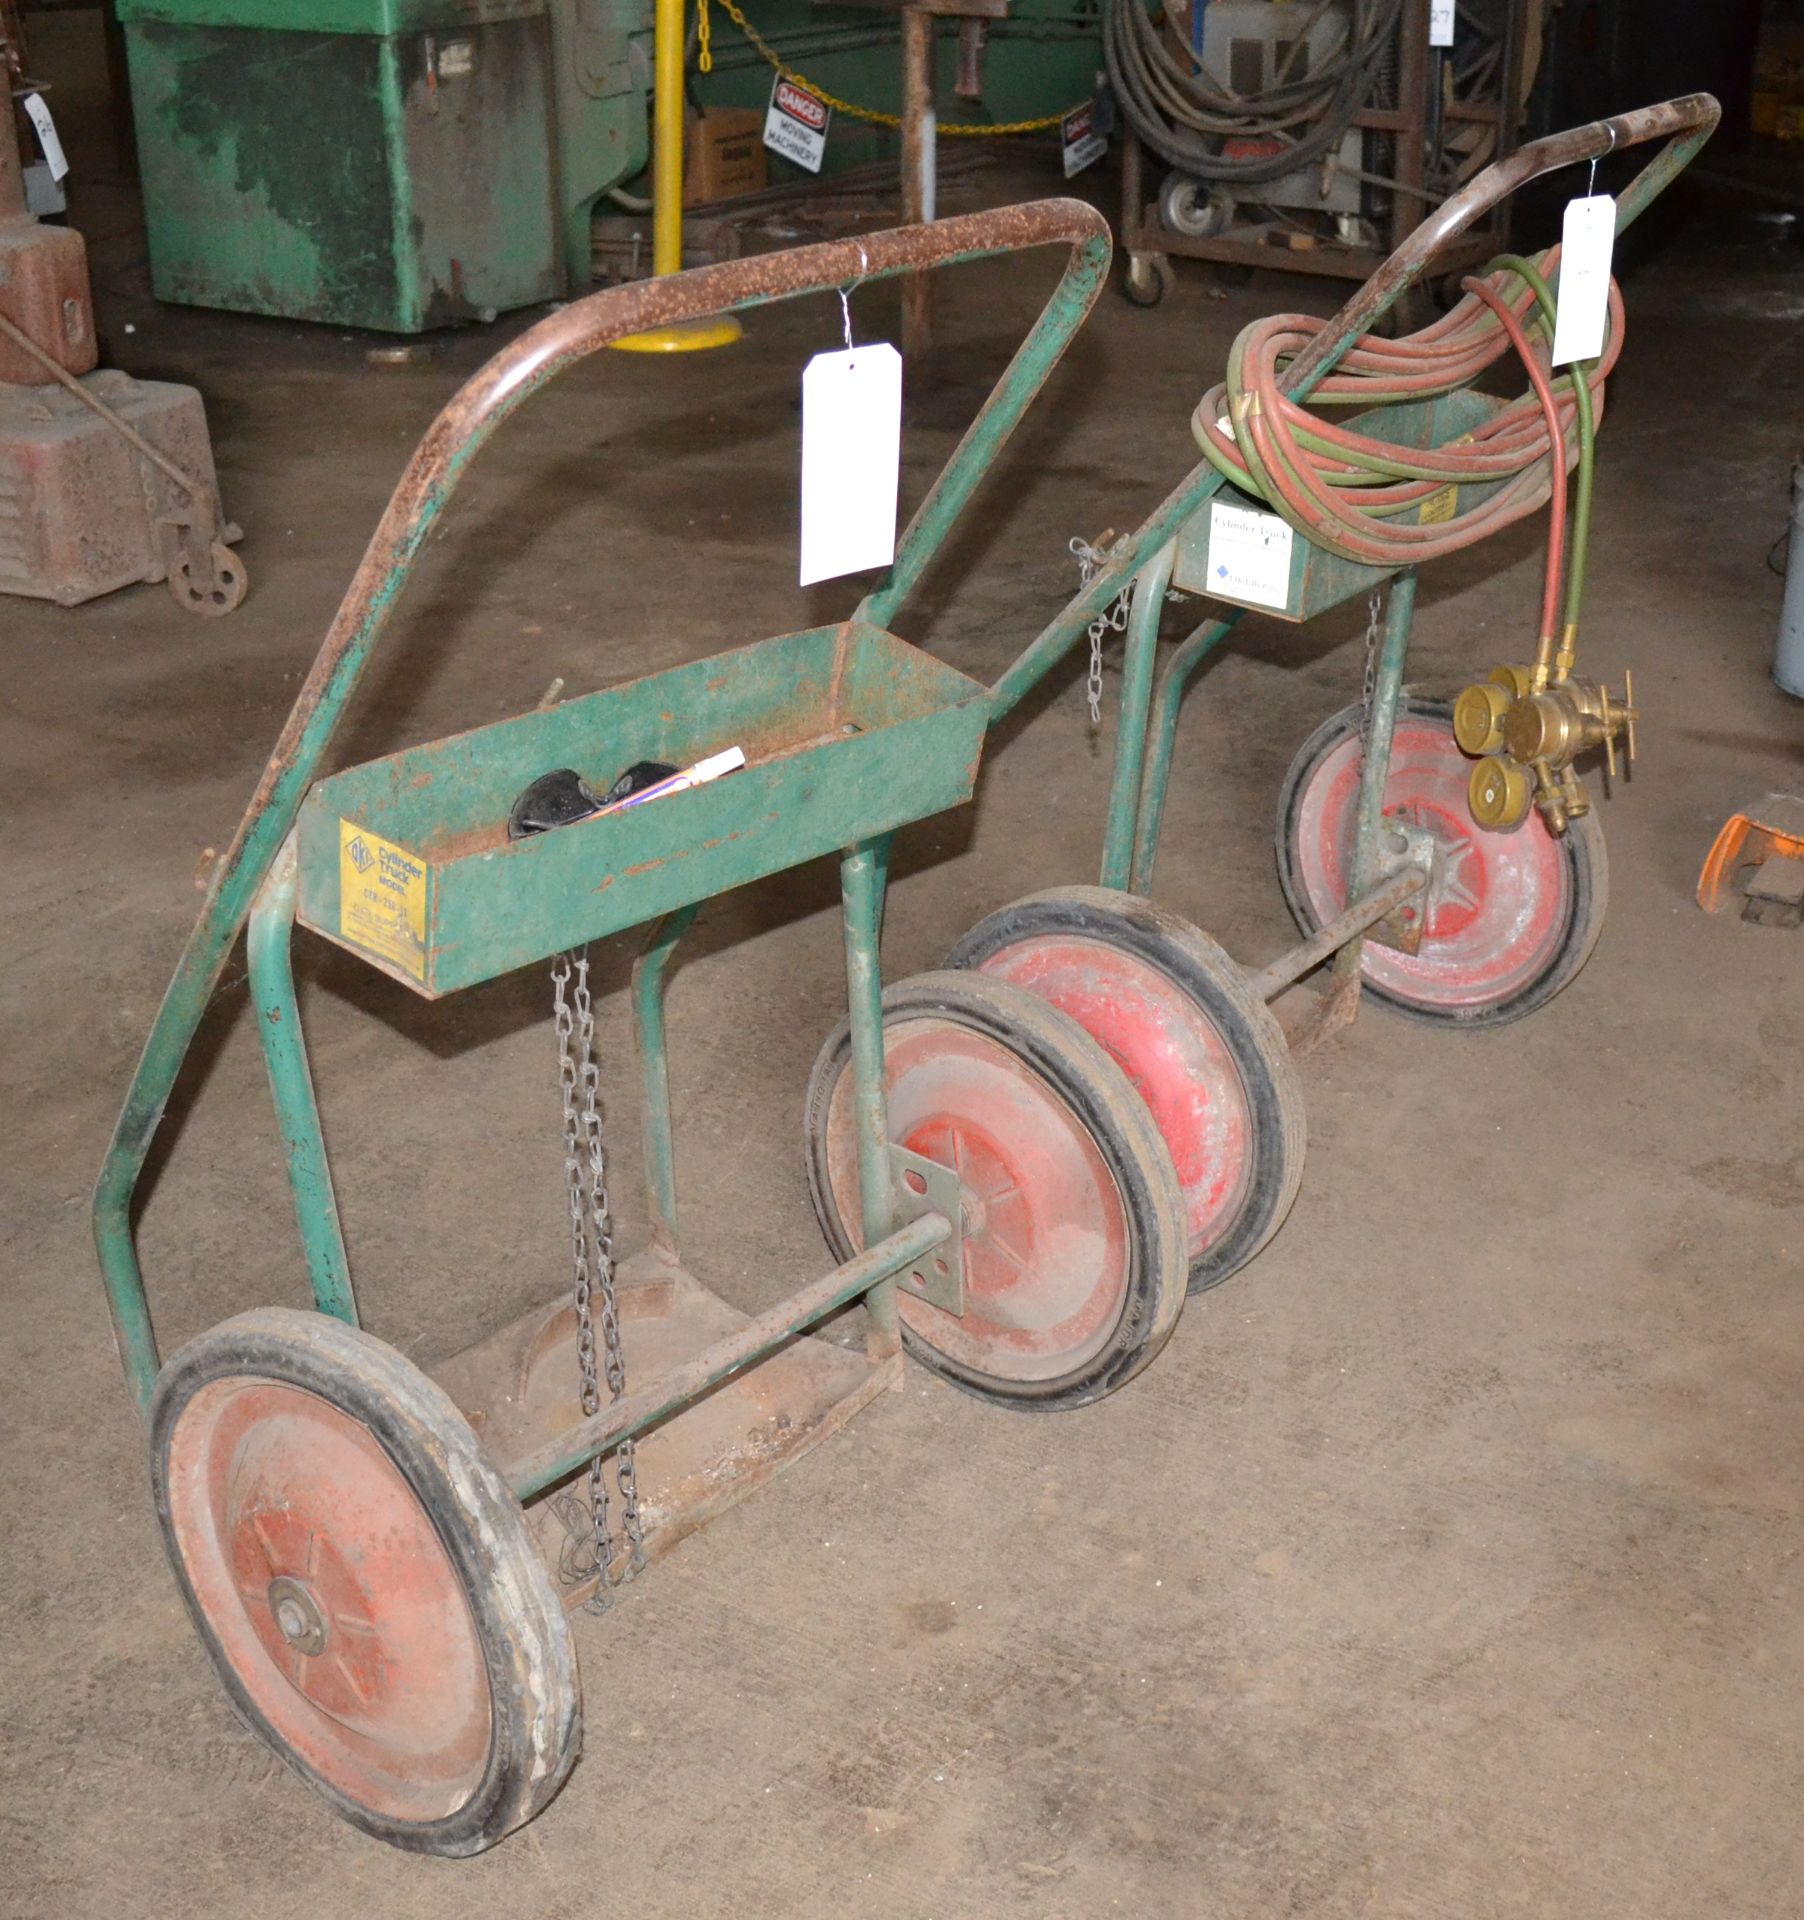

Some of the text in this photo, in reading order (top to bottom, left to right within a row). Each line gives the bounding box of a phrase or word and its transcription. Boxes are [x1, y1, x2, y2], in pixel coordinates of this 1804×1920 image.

[779, 86, 823, 121] DANGER
[767, 129, 817, 164] MACHINERY
[781, 119, 812, 145] MOVING
[378, 847, 423, 879] Cylinder
[378, 859, 409, 885] Truck
